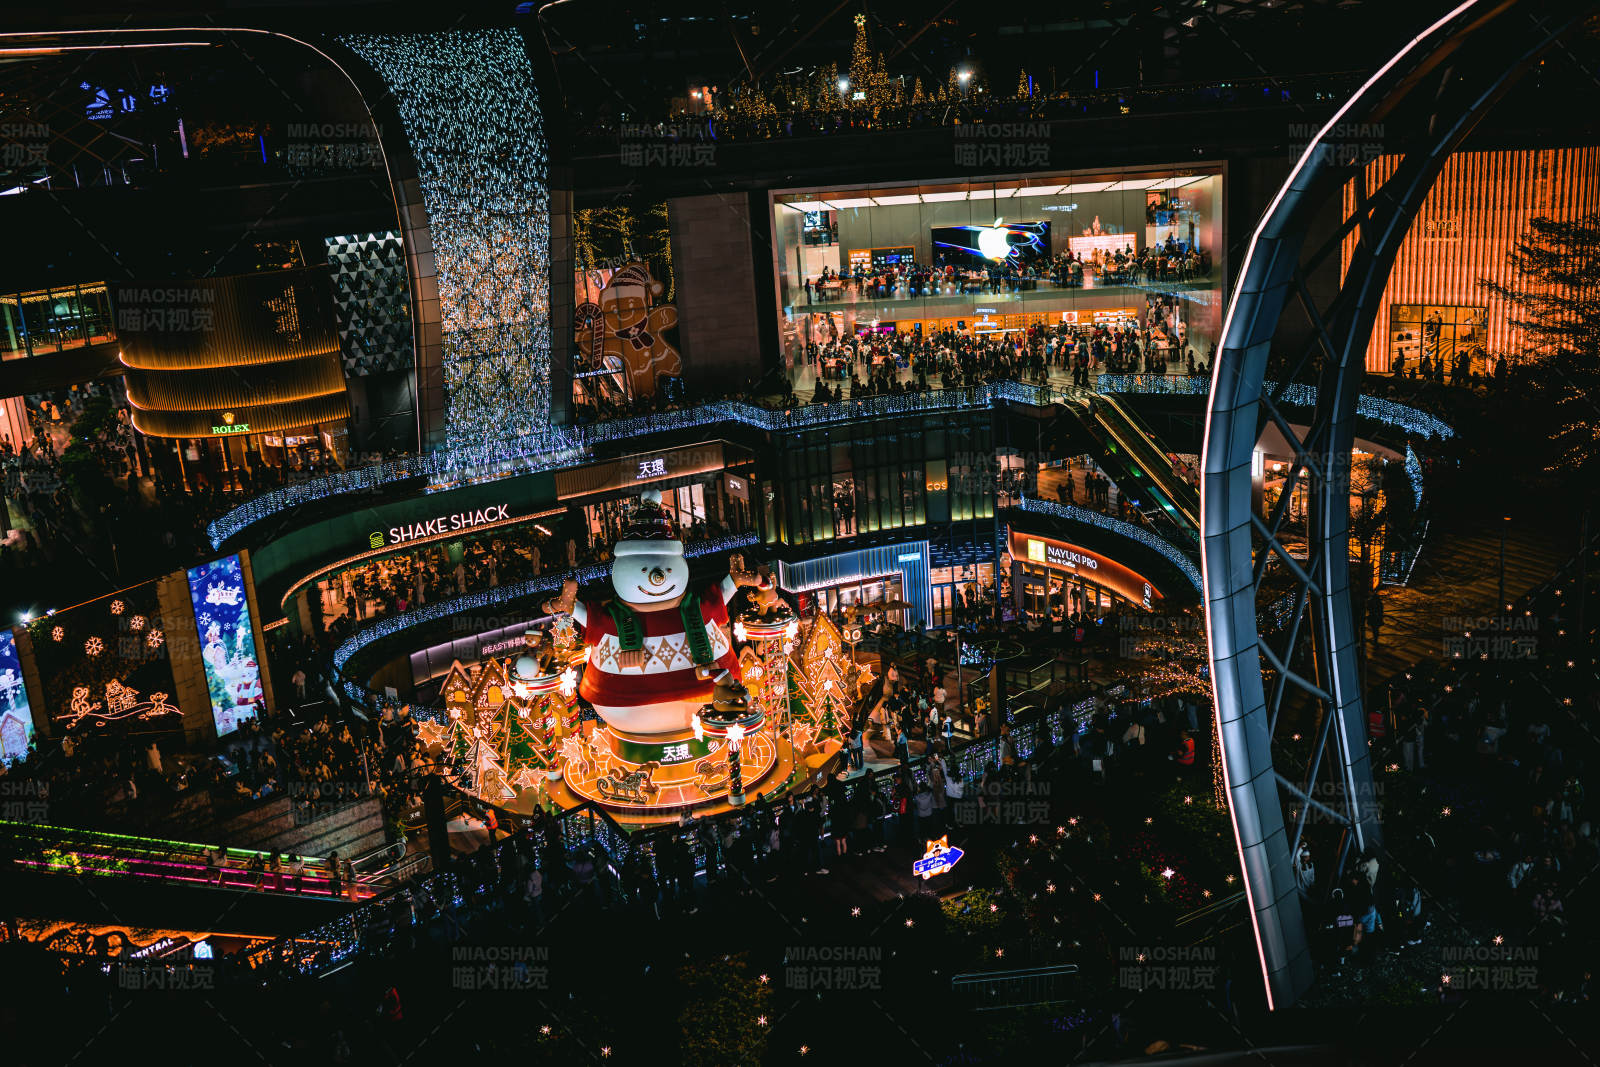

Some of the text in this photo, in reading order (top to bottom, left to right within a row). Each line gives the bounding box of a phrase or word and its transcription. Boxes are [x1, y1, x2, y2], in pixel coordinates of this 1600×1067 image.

[211, 424, 250, 434] ROLEX
[926, 482, 948, 491] COS
[390, 503, 510, 544] SHAKE SHACK
[1047, 545, 1081, 564] NAYUKI
[1082, 555, 1098, 570] PRO
